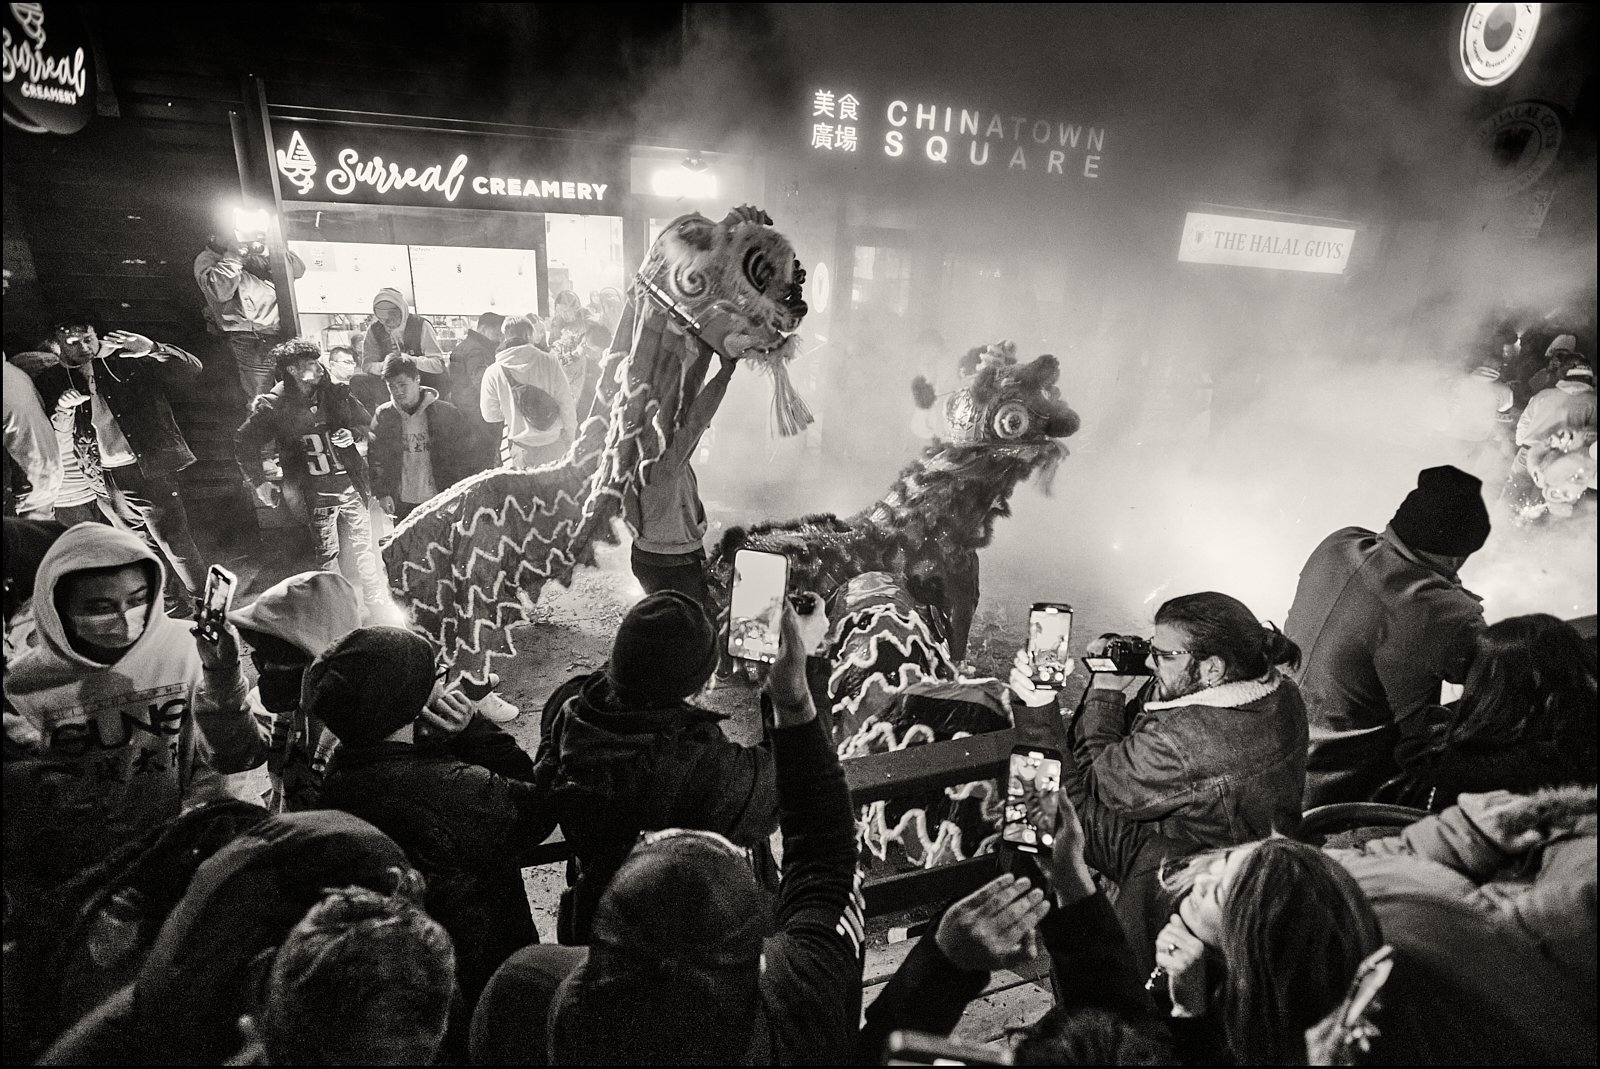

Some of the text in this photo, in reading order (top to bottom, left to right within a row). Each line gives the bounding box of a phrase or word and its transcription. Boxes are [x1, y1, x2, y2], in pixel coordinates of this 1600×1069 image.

[21, 81, 77, 105] CREAMERY
[813, 89, 860, 121] 美食
[811, 122, 858, 152] 廣場
[887, 100, 1105, 151] CHINATOWN
[884, 130, 1101, 178] SQUARE
[326, 148, 608, 202] Surreal CREAMERY
[1214, 231, 1344, 259] THE HALAL GUYS
